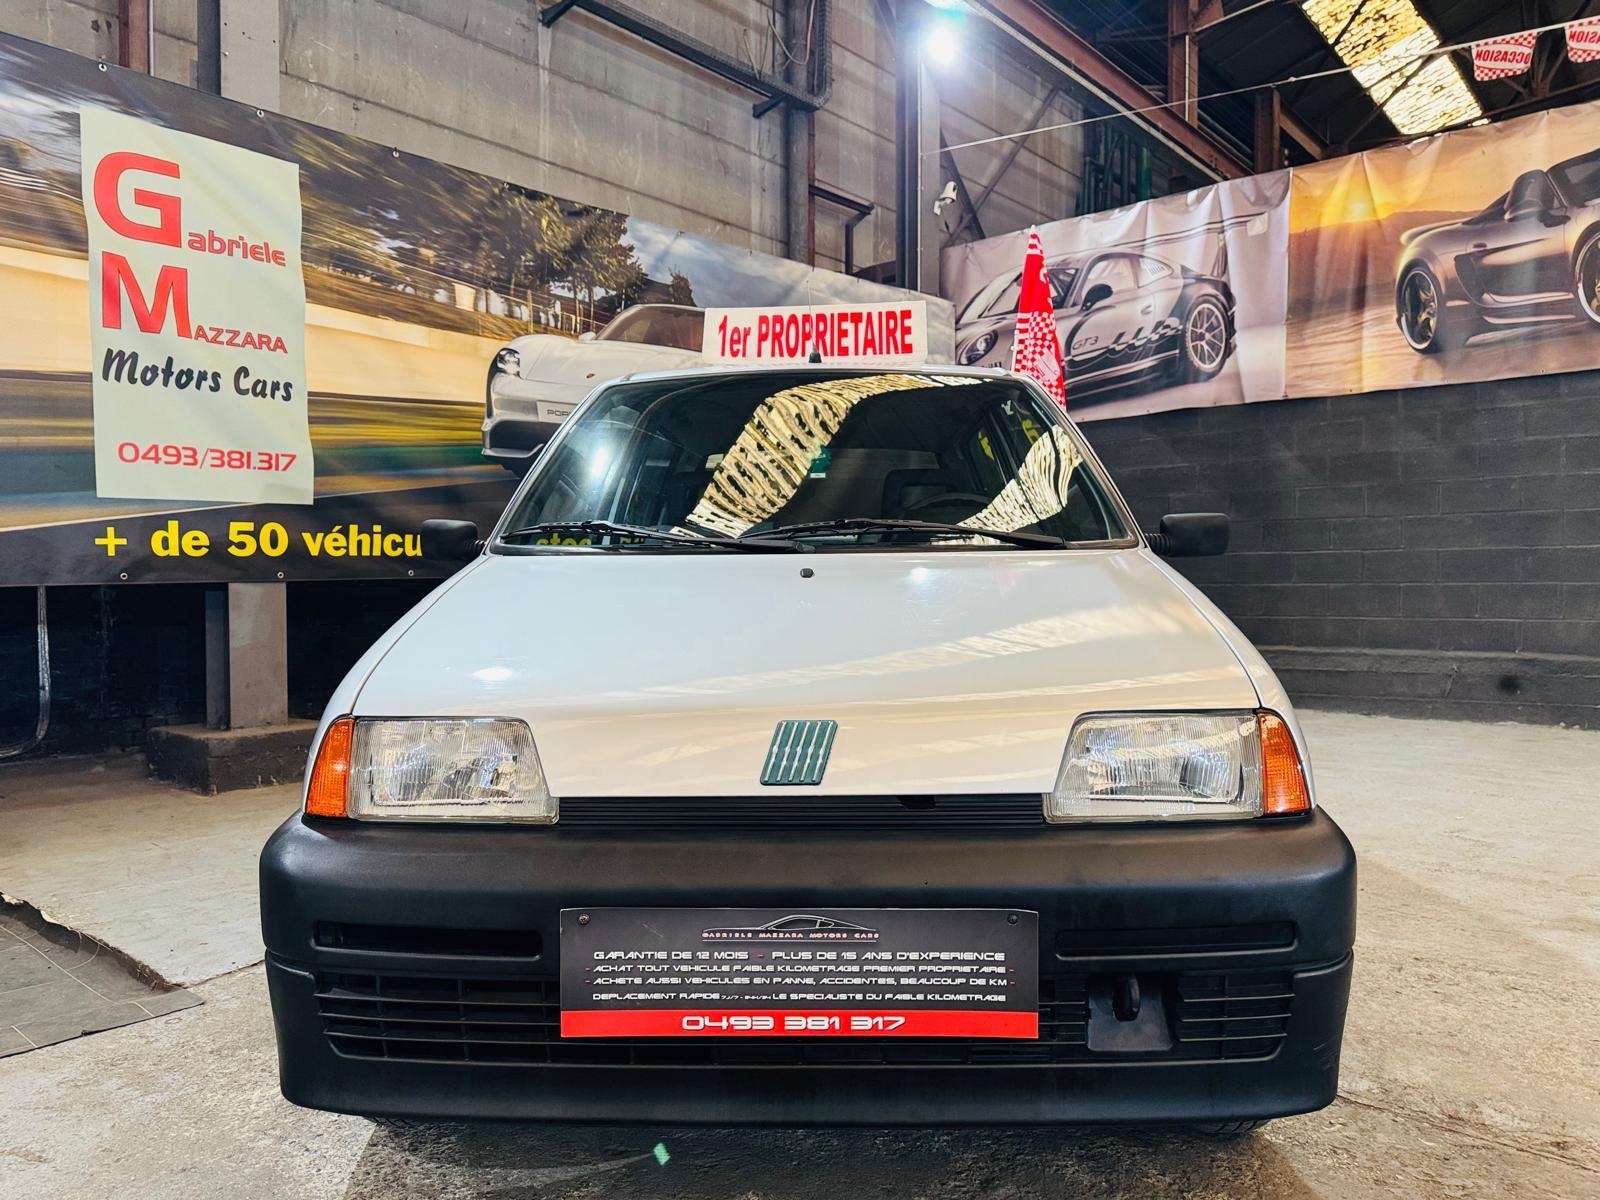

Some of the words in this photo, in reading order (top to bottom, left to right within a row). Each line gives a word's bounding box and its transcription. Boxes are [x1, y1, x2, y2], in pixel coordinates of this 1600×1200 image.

[717, 314, 751, 358] 1er
[756, 309, 914, 358] PROPRIETAIRE
[101, 348, 221, 393] Motors
[233, 365, 294, 403] Cars
[117, 441, 298, 472] 0493/381.317
[150, 520, 210, 558] de
[226, 521, 289, 559] 50
[301, 524, 422, 558] véhicu
[593, 951, 668, 960] GARANTIE
[671, 951, 693, 960] DE
[696, 951, 710, 960] 12
[713, 951, 749, 960] MOIS
[771, 951, 813, 961] PLUS
[816, 951, 838, 961] DE
[841, 951, 857, 961] 15
[860, 951, 893, 961] ANS
[896, 951, 1006, 961] D'EXPERIENCE
[593, 965, 634, 973] ACHAT
[636, 965, 671, 973] TOUT
[673, 965, 730, 973] VEHICULE
[733, 965, 775, 973] FAIBLE
[777, 965, 860, 973] KILOMETRAGE
[863, 965, 916, 974] PREMIER
[918, 965, 1006, 974] PROPRIETAIRE
[593, 977, 643, 985] ACHETE
[645, 977, 682, 985] AUSSI
[684, 977, 751, 985] VEHICULES
[753, 977, 770, 985] EN
[772, 977, 816, 986] PANNE,
[819, 977, 898, 986] ACCIDENTES,
[900, 977, 967, 986] BEAUCOUP
[969, 977, 987, 986] DE
[988, 977, 1008, 987] KM
[592, 993, 678, 1001] DEPLACEMENT
[679, 993, 721, 1001] RAPIDE
[772, 993, 789, 1001] LE
[789, 993, 864, 1001] SPECIALISTE
[865, 993, 883, 1001] DU
[884, 993, 925, 1001] FAIBLE
[926, 993, 1007, 1002] KILOMETRAGE
[681, 1015, 775, 1030] 0493
[783, 1015, 840, 1030] 381
[850, 1015, 906, 1030] 317
